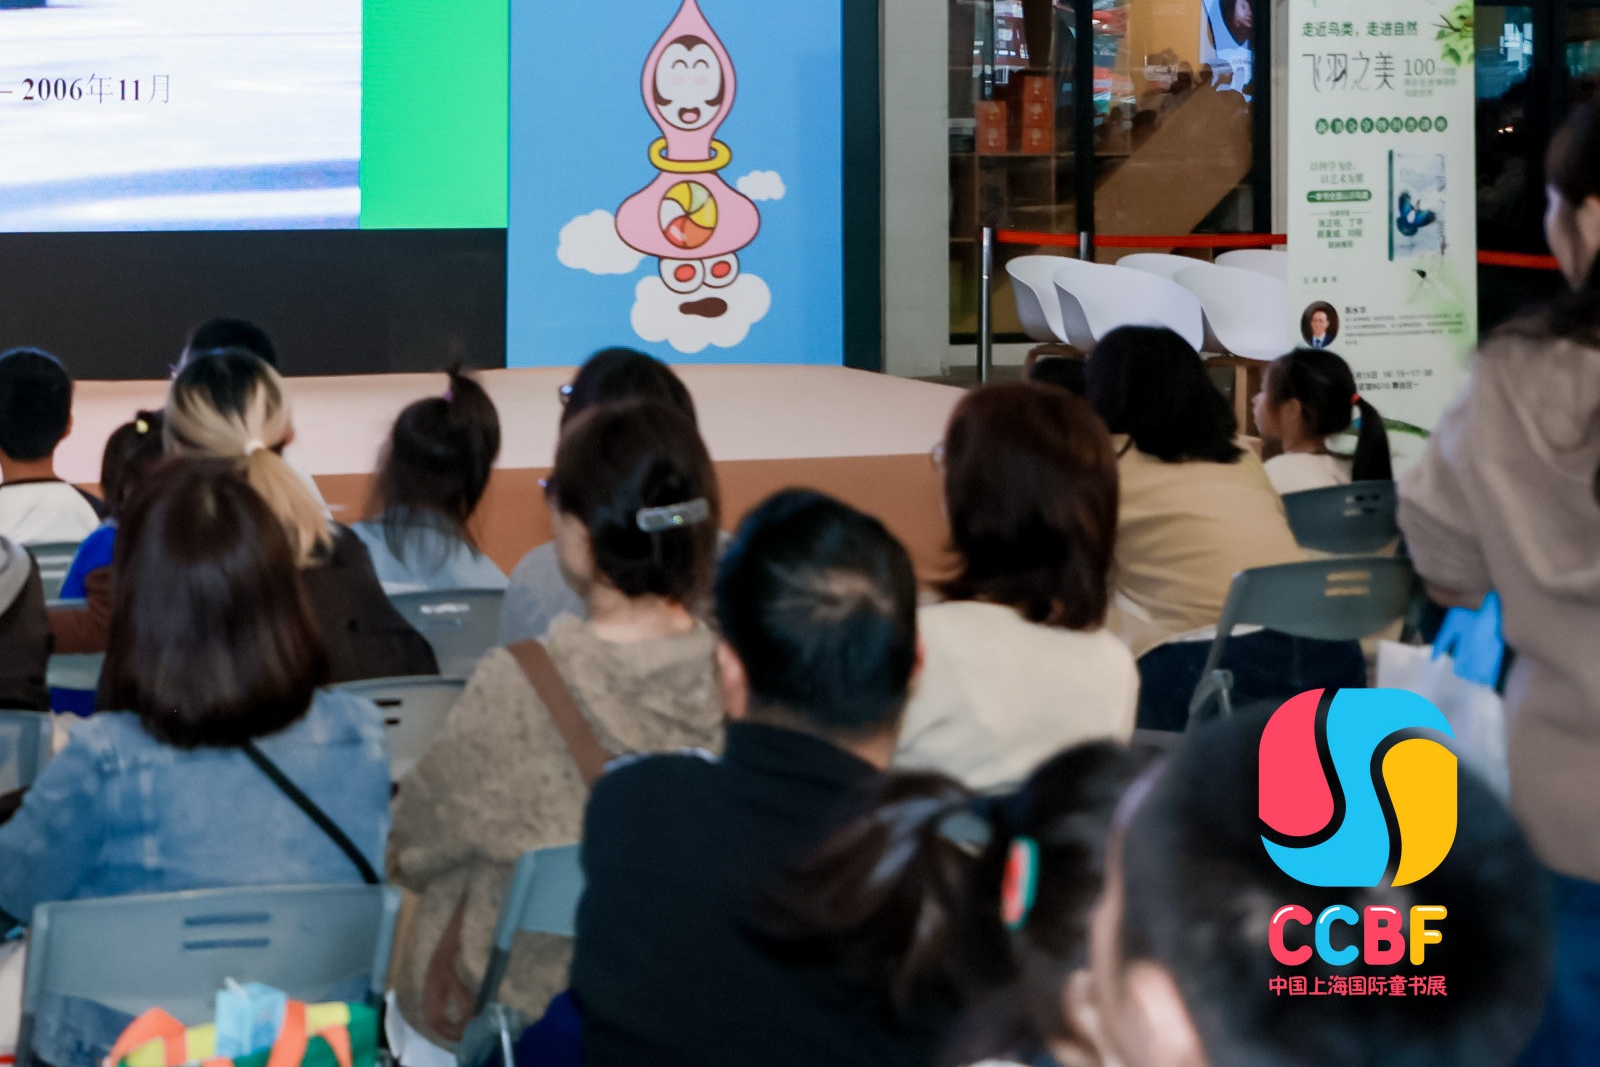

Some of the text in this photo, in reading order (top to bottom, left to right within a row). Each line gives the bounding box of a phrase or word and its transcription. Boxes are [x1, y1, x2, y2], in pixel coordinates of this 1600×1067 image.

[21, 73, 172, 104] 2006年11月
[1302, 51, 1395, 93] 飞羽之美
